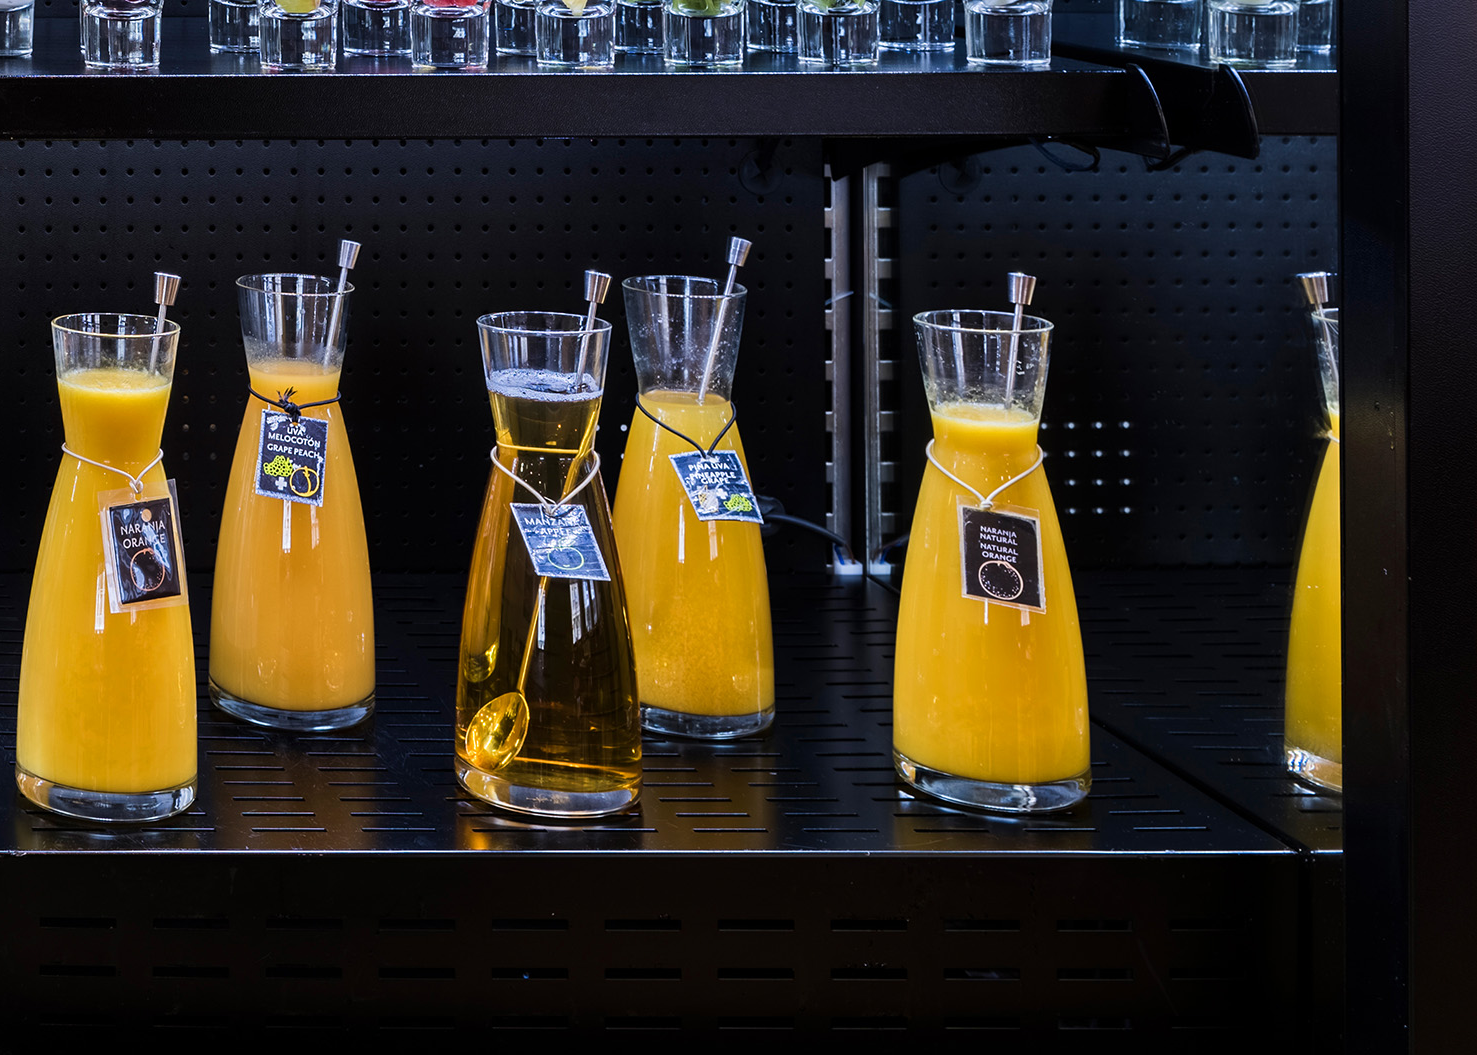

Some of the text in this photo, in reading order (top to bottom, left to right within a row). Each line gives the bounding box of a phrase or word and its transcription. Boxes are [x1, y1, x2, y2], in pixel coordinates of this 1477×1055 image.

[287, 426, 304, 437] UVA
[267, 431, 321, 448] MELOCOTÓN
[267, 443, 320, 459] GRAPE PEACH
[710, 462, 730, 470] UVA
[700, 477, 730, 485] GRAPE
[120, 519, 166, 536] NARANJA
[980, 525, 1017, 539] NARANJA
[979, 532, 1018, 546] NATURAL
[979, 542, 1018, 556] NATURAL
[981, 550, 1017, 563] ORANGE
